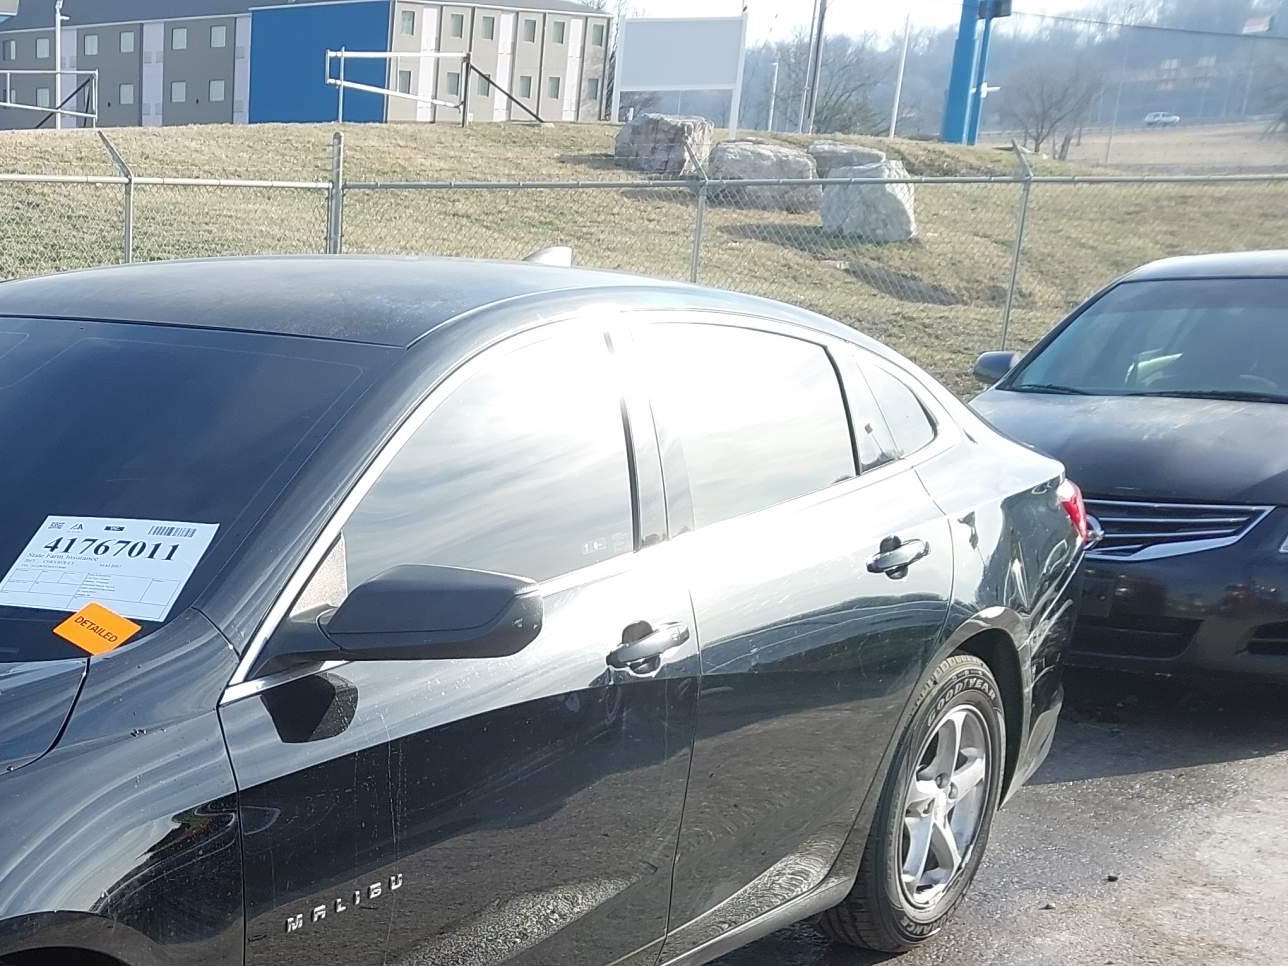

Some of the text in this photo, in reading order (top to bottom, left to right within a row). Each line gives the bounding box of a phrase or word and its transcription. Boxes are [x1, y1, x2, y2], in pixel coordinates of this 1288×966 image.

[44, 536, 179, 561] 41767011
[74, 615, 118, 643] DETAILED
[927, 678, 996, 727] GOODYEAR
[286, 873, 403, 933] MALIBU
